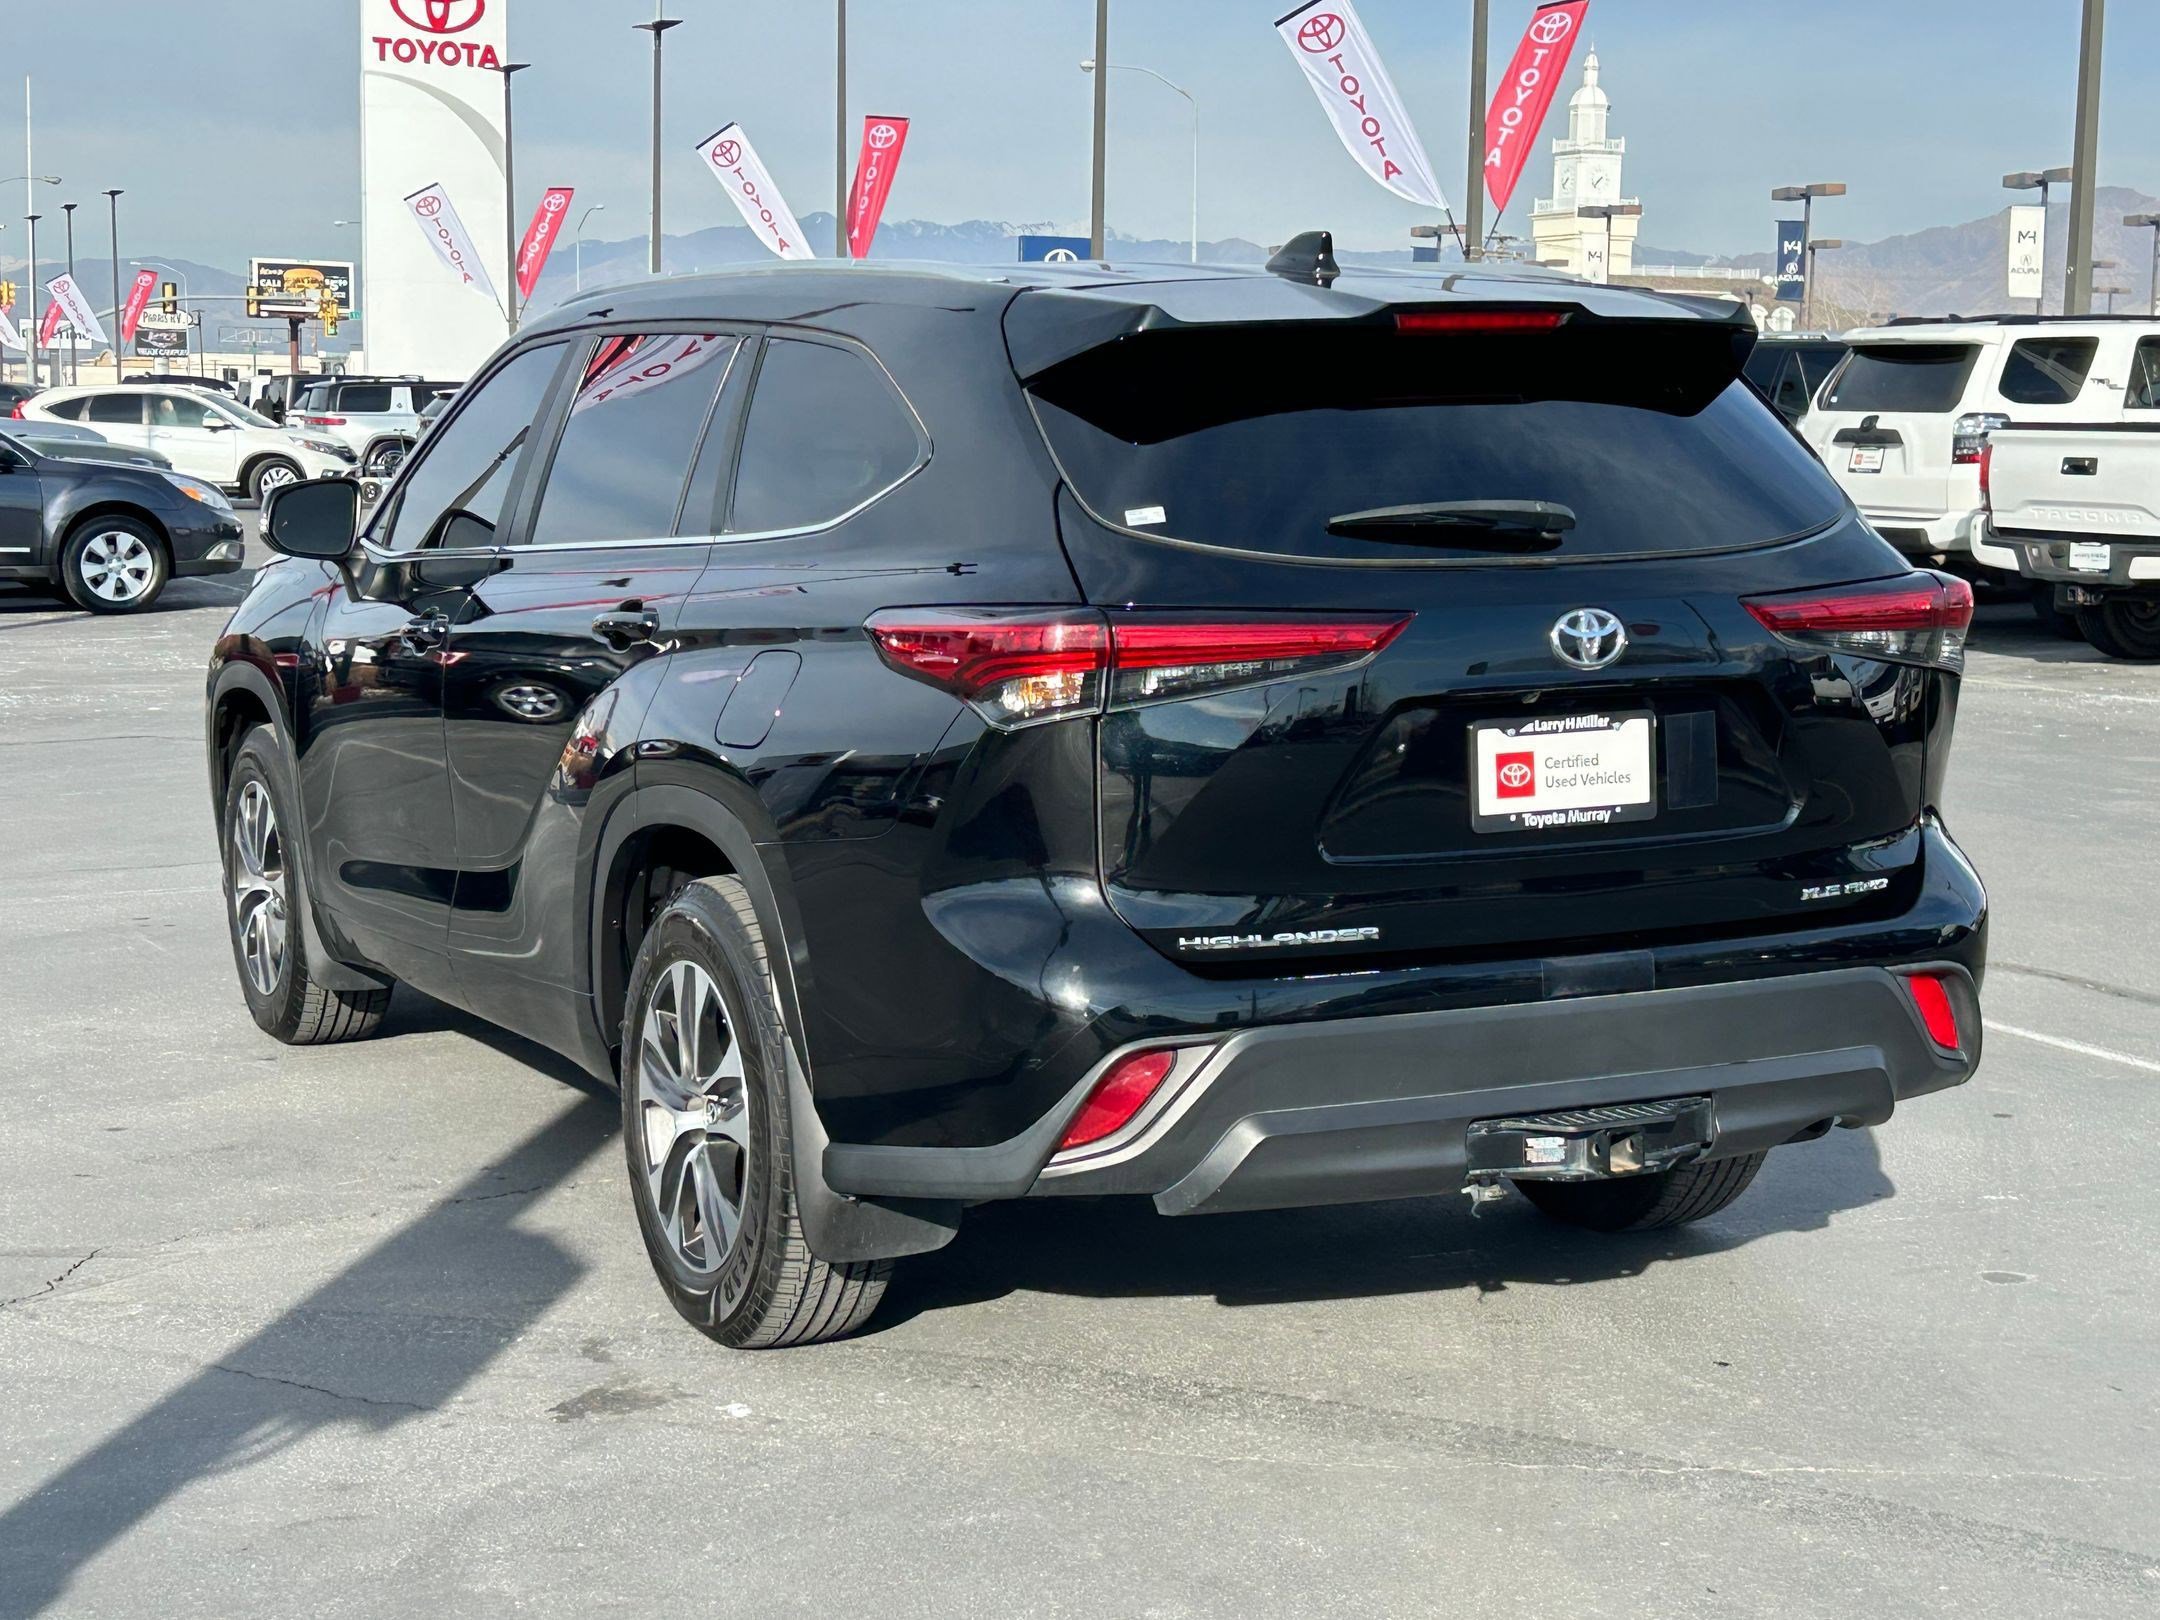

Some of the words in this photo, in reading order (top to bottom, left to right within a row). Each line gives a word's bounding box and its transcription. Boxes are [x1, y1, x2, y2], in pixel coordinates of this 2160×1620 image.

[372, 37, 500, 69] TOYOTA
[1328, 53, 1403, 181] TOYOTA
[1484, 48, 1549, 168] TOYOTA
[733, 166, 790, 252] TOYOTA
[851, 151, 882, 239] TOYOTA
[432, 217, 474, 284] TOYOTA
[518, 212, 554, 275] TOYOTA
[64, 293, 92, 334] TOYOTA
[2030, 508, 2142, 523] TACOMA
[1534, 719, 1565, 733] Larry
[1577, 714, 1610, 729] Miller
[1544, 753, 1600, 769] Certified
[1545, 774, 1577, 788] Used
[1580, 771, 1631, 786] Vehicles
[1522, 810, 1566, 828] Toyota
[1567, 809, 1612, 825] Murray
[1179, 926, 1380, 950] HIGHLANDER
